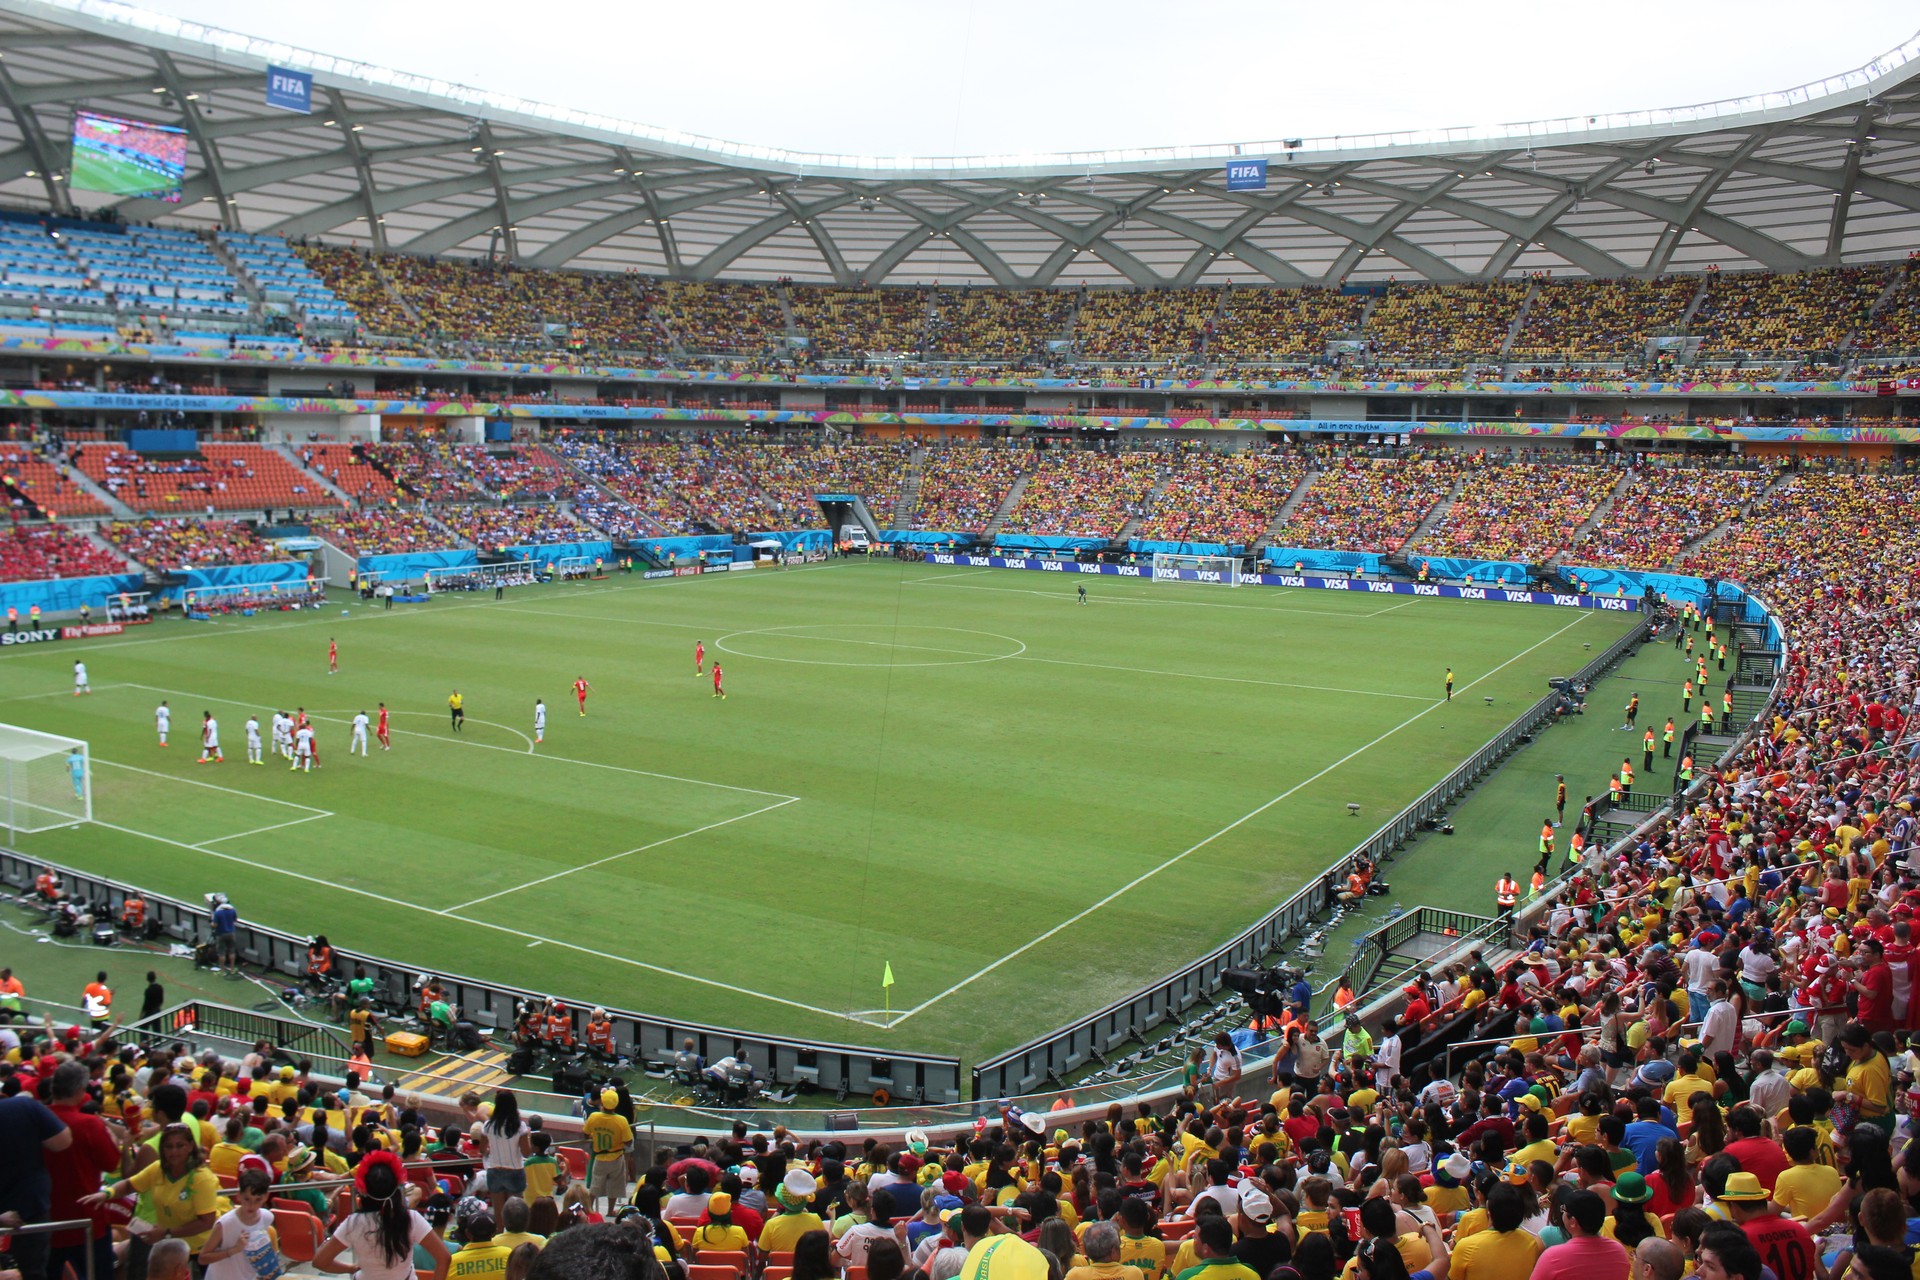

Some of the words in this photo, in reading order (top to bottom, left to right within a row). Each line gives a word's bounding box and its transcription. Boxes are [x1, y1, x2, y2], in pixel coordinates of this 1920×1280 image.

[272, 75, 305, 96] FIFA
[1230, 166, 1259, 178] FIFA
[1318, 422, 1328, 430] All
[1330, 422, 1337, 430] in
[933, 554, 955, 564] VISA
[968, 556, 990, 566] VISA
[1004, 558, 1026, 569] VISA
[1040, 560, 1063, 571] VISA
[1078, 563, 1101, 574] VISA
[1116, 565, 1140, 576] VISA
[1156, 568, 1180, 579] VISA
[1195, 570, 1221, 581] VISA
[1238, 573, 1263, 585] VISA
[1279, 575, 1305, 587] VISA
[1322, 578, 1349, 590] VISA
[1366, 581, 1394, 593] VISA
[1411, 584, 1439, 596] VISA
[1458, 587, 1486, 599] VISA
[1504, 591, 1532, 603] VISA
[1551, 594, 1580, 607] VISA
[1598, 598, 1628, 611] VISA
[1, 628, 57, 645] SONY
[64, 626, 82, 638] Fly
[82, 624, 122, 635] Emirates
[596, 1132, 613, 1151] 10
[1757, 1229, 1798, 1244] ROONEY
[1766, 1240, 1807, 1280] 10
[456, 1257, 507, 1276] BRASIL
